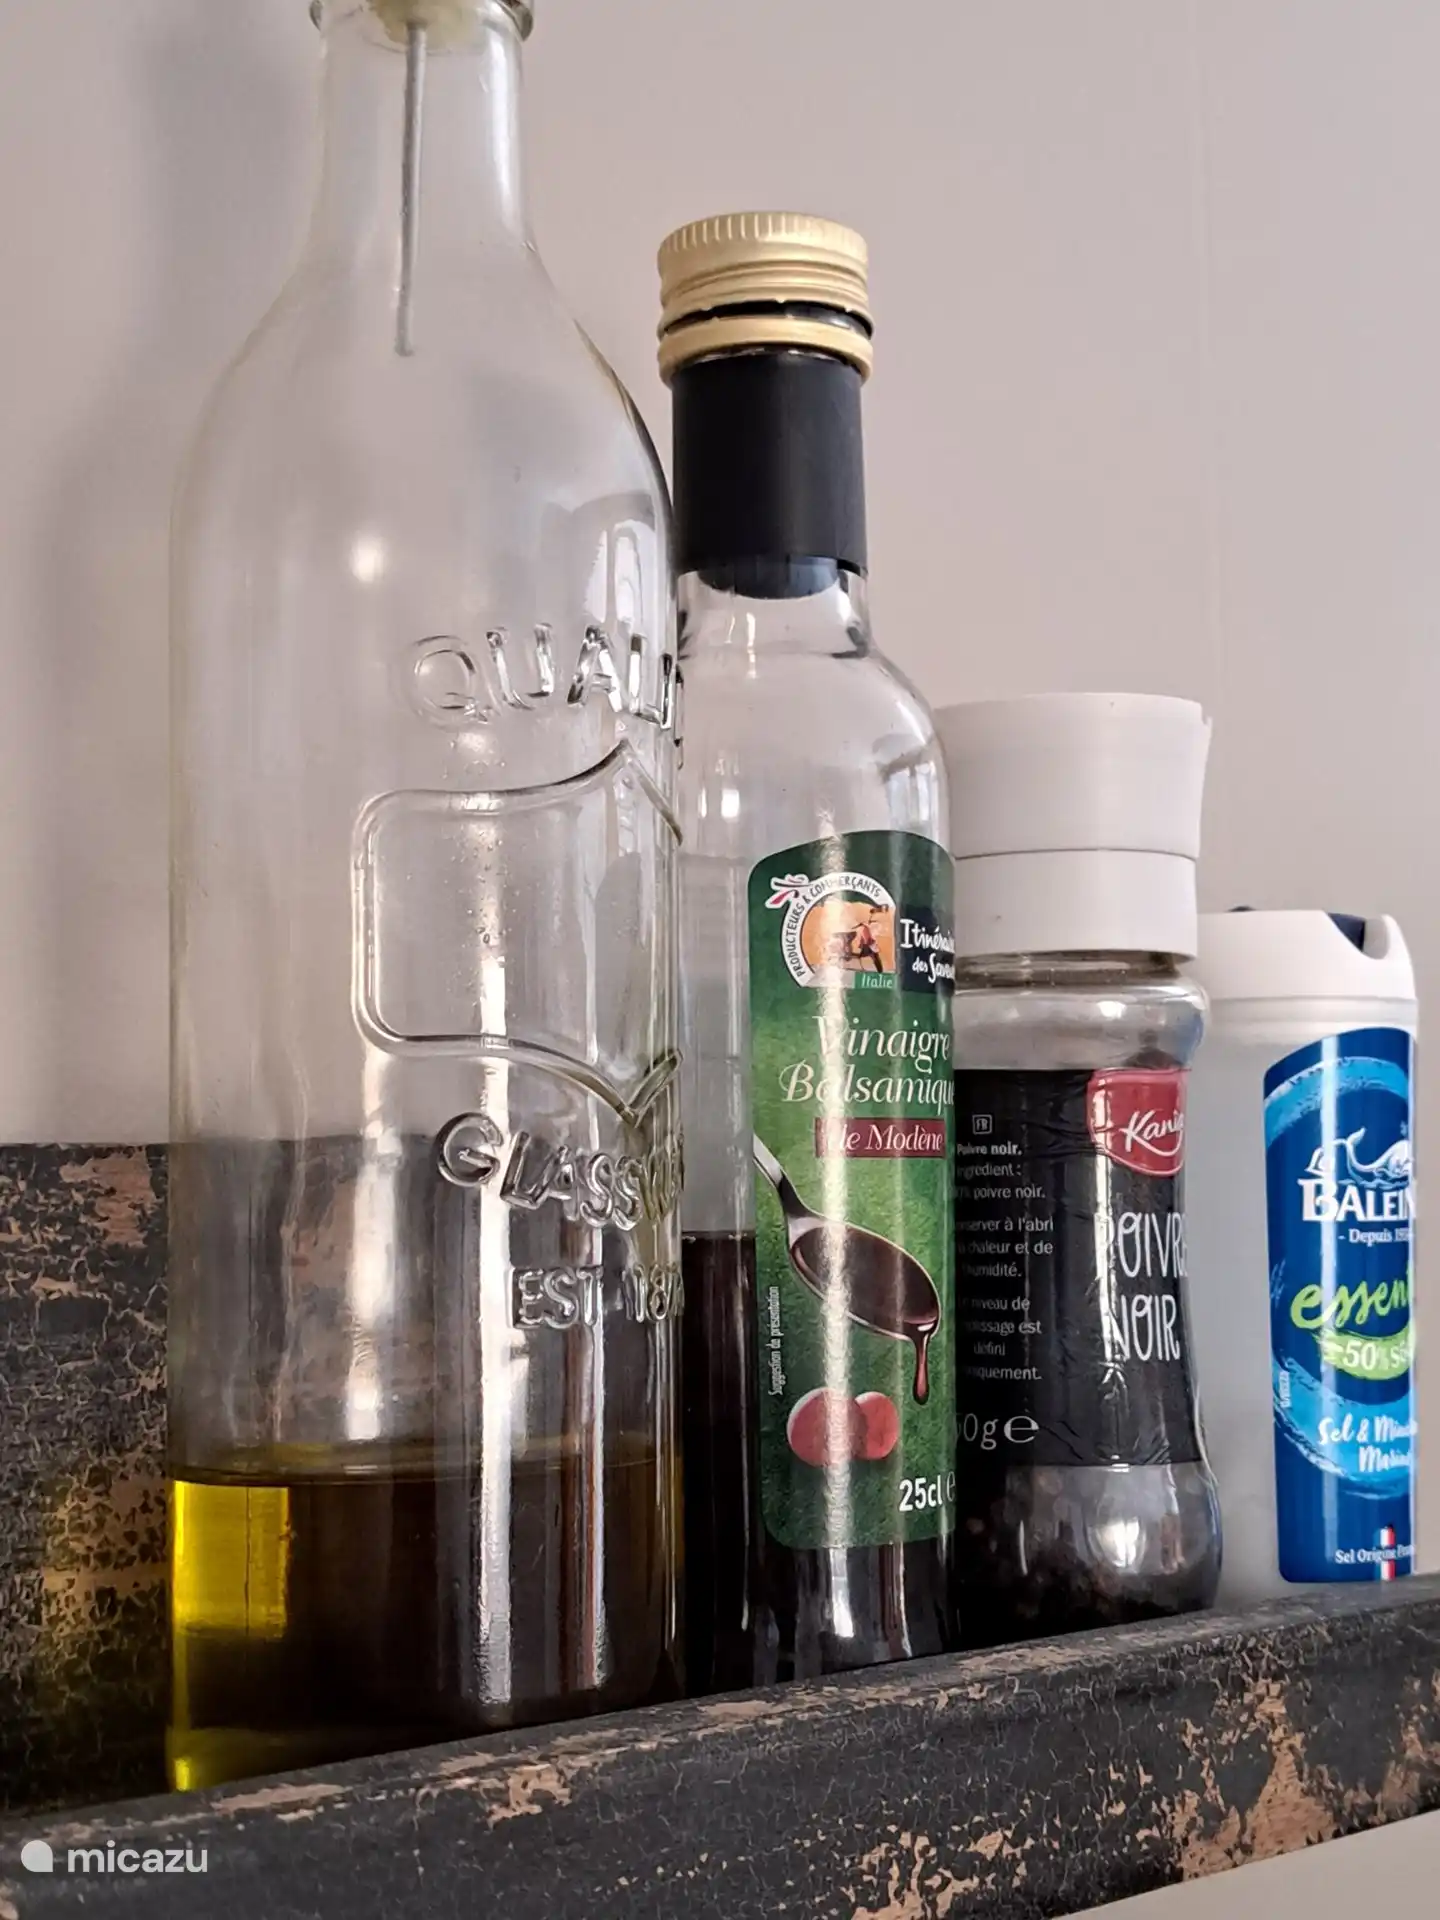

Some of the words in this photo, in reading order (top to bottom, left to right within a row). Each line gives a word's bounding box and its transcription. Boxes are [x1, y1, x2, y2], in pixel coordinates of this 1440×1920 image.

[785, 902, 806, 977] PRODUCTEURS
[810, 875, 882, 898] COMERÇANTS
[911, 956, 928, 974] des
[861, 974, 893, 989] Italie
[812, 1015, 950, 1075] Vinaigre
[864, 1124, 943, 1151] Modène
[991, 1140, 1022, 1156] noir.
[973, 1184, 1012, 1200] poivre
[1015, 1182, 1046, 1199] noir.
[1297, 1179, 1417, 1222] BALEIN
[1004, 1216, 1014, 1231] à
[1018, 1215, 1054, 1232] l'abri
[1015, 1241, 1030, 1254] et
[1033, 1240, 1054, 1254] de
[508, 1266, 604, 1330] EST
[765, 1286, 784, 1336] présentation
[1012, 1296, 1031, 1311] de
[1018, 1320, 1043, 1334] est
[1101, 1294, 1180, 1361] NOIR
[767, 1351, 787, 1395] Suggestion
[1318, 1413, 1354, 1445] Sel
[1356, 1418, 1370, 1443] &
[899, 1474, 943, 1512] 25cl
[1335, 1549, 1356, 1564] Sel
